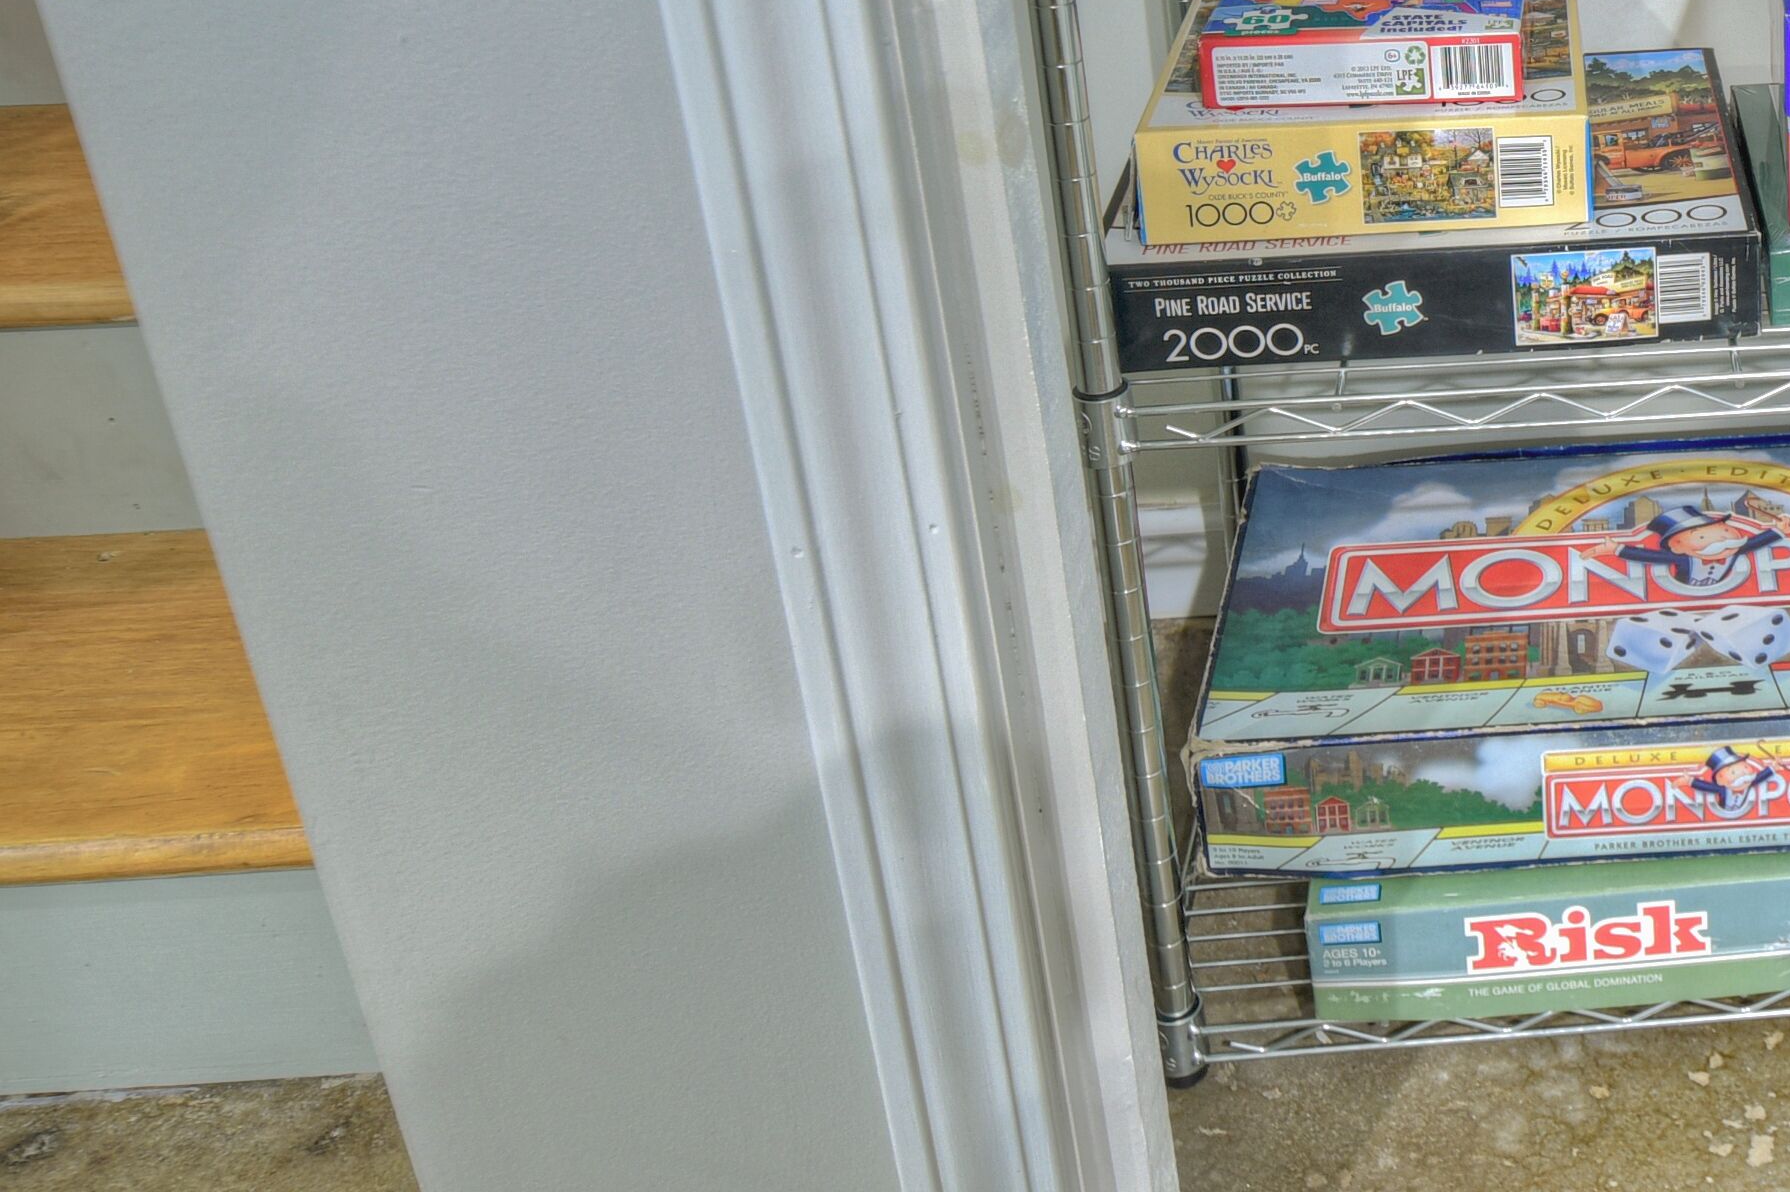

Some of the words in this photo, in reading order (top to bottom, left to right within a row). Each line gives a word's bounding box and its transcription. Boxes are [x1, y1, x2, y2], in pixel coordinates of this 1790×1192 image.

[1242, 13, 1290, 25] 60
[1396, 69, 1414, 80] LPF
[1303, 171, 1342, 182] Buffalo
[1208, 192, 1227, 201] OLDE
[1227, 192, 1254, 200] BUCK'S
[1254, 191, 1286, 200] COUNTY
[1186, 201, 1275, 228] 1000
[1142, 242, 1192, 255] PINE
[1199, 239, 1256, 252] ROAD
[1265, 235, 1352, 250] SERVICE
[1128, 280, 1150, 289] TWO
[1153, 276, 1205, 287] THOUSAND
[1208, 274, 1235, 284] PIECE
[1239, 273, 1275, 283] PUZZLE
[1277, 269, 1337, 281] COLLECTION
[1155, 297, 1192, 318] PINE
[1197, 294, 1240, 316] ROAD
[1246, 291, 1313, 314] SERVICE
[1373, 302, 1413, 314] Buffalo
[1163, 323, 1304, 362] 2000
[1304, 343, 1320, 355] PC
[1536, 470, 1663, 531] DELUXE
[1225, 757, 1280, 773] PARKER
[1575, 751, 1678, 766] DELUXE
[1207, 768, 1281, 785] BROTHERS
[1450, 836, 1525, 846] VENTNOR
[1451, 841, 1518, 851] AVENUE
[1594, 840, 1638, 851] PARKER
[1642, 838, 1701, 850] BROTHERS
[1706, 835, 1733, 845] REAL
[1739, 832, 1778, 843] ESTATE
[1468, 904, 1707, 972] Risk
[1468, 986, 1490, 997] THE
[1492, 985, 1525, 997] GAME
[1528, 983, 1543, 994] OF
[1546, 979, 1590, 992] GLOBAL
[1593, 973, 1663, 989] DOMINATION
